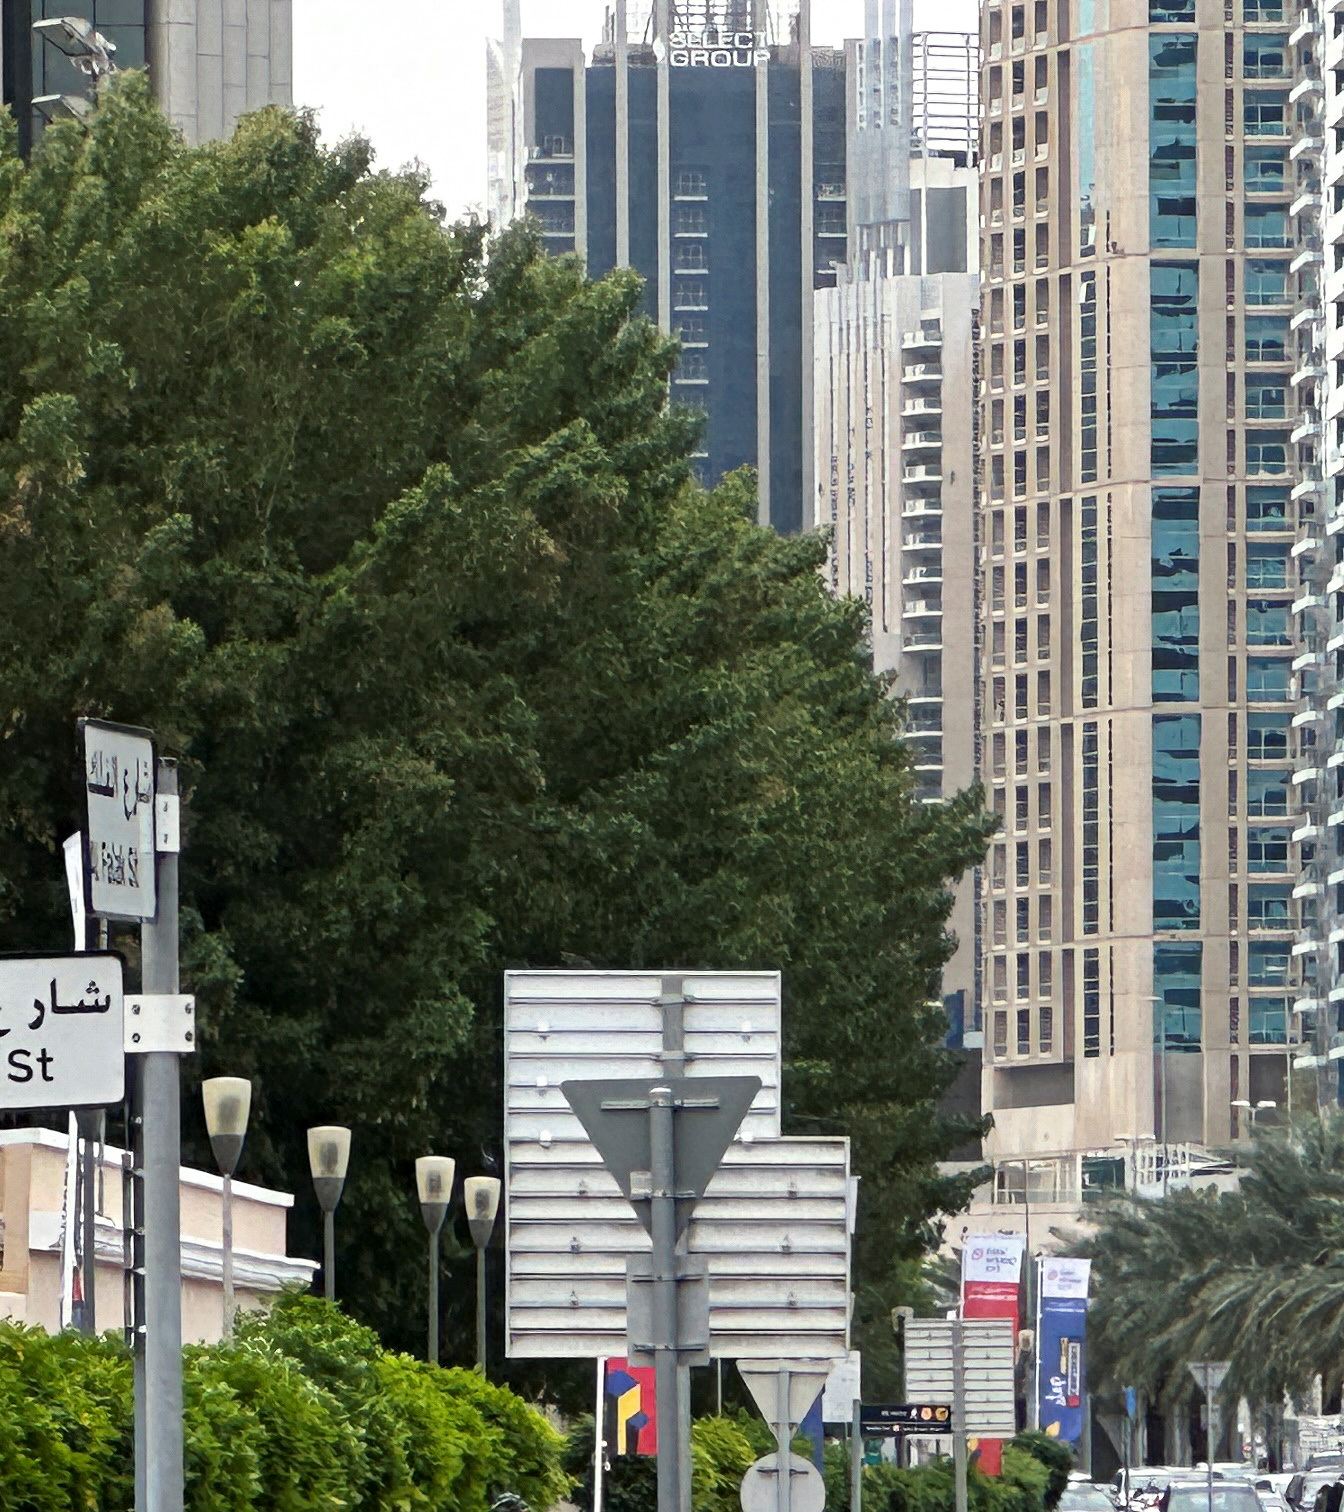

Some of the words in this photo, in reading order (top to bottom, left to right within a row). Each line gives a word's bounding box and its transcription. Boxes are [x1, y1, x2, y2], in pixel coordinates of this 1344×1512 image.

[669, 32, 767, 48] SELECT
[670, 50, 770, 66] GROUP
[0, 978, 111, 1038] شار
[8, 1048, 54, 1083] St
